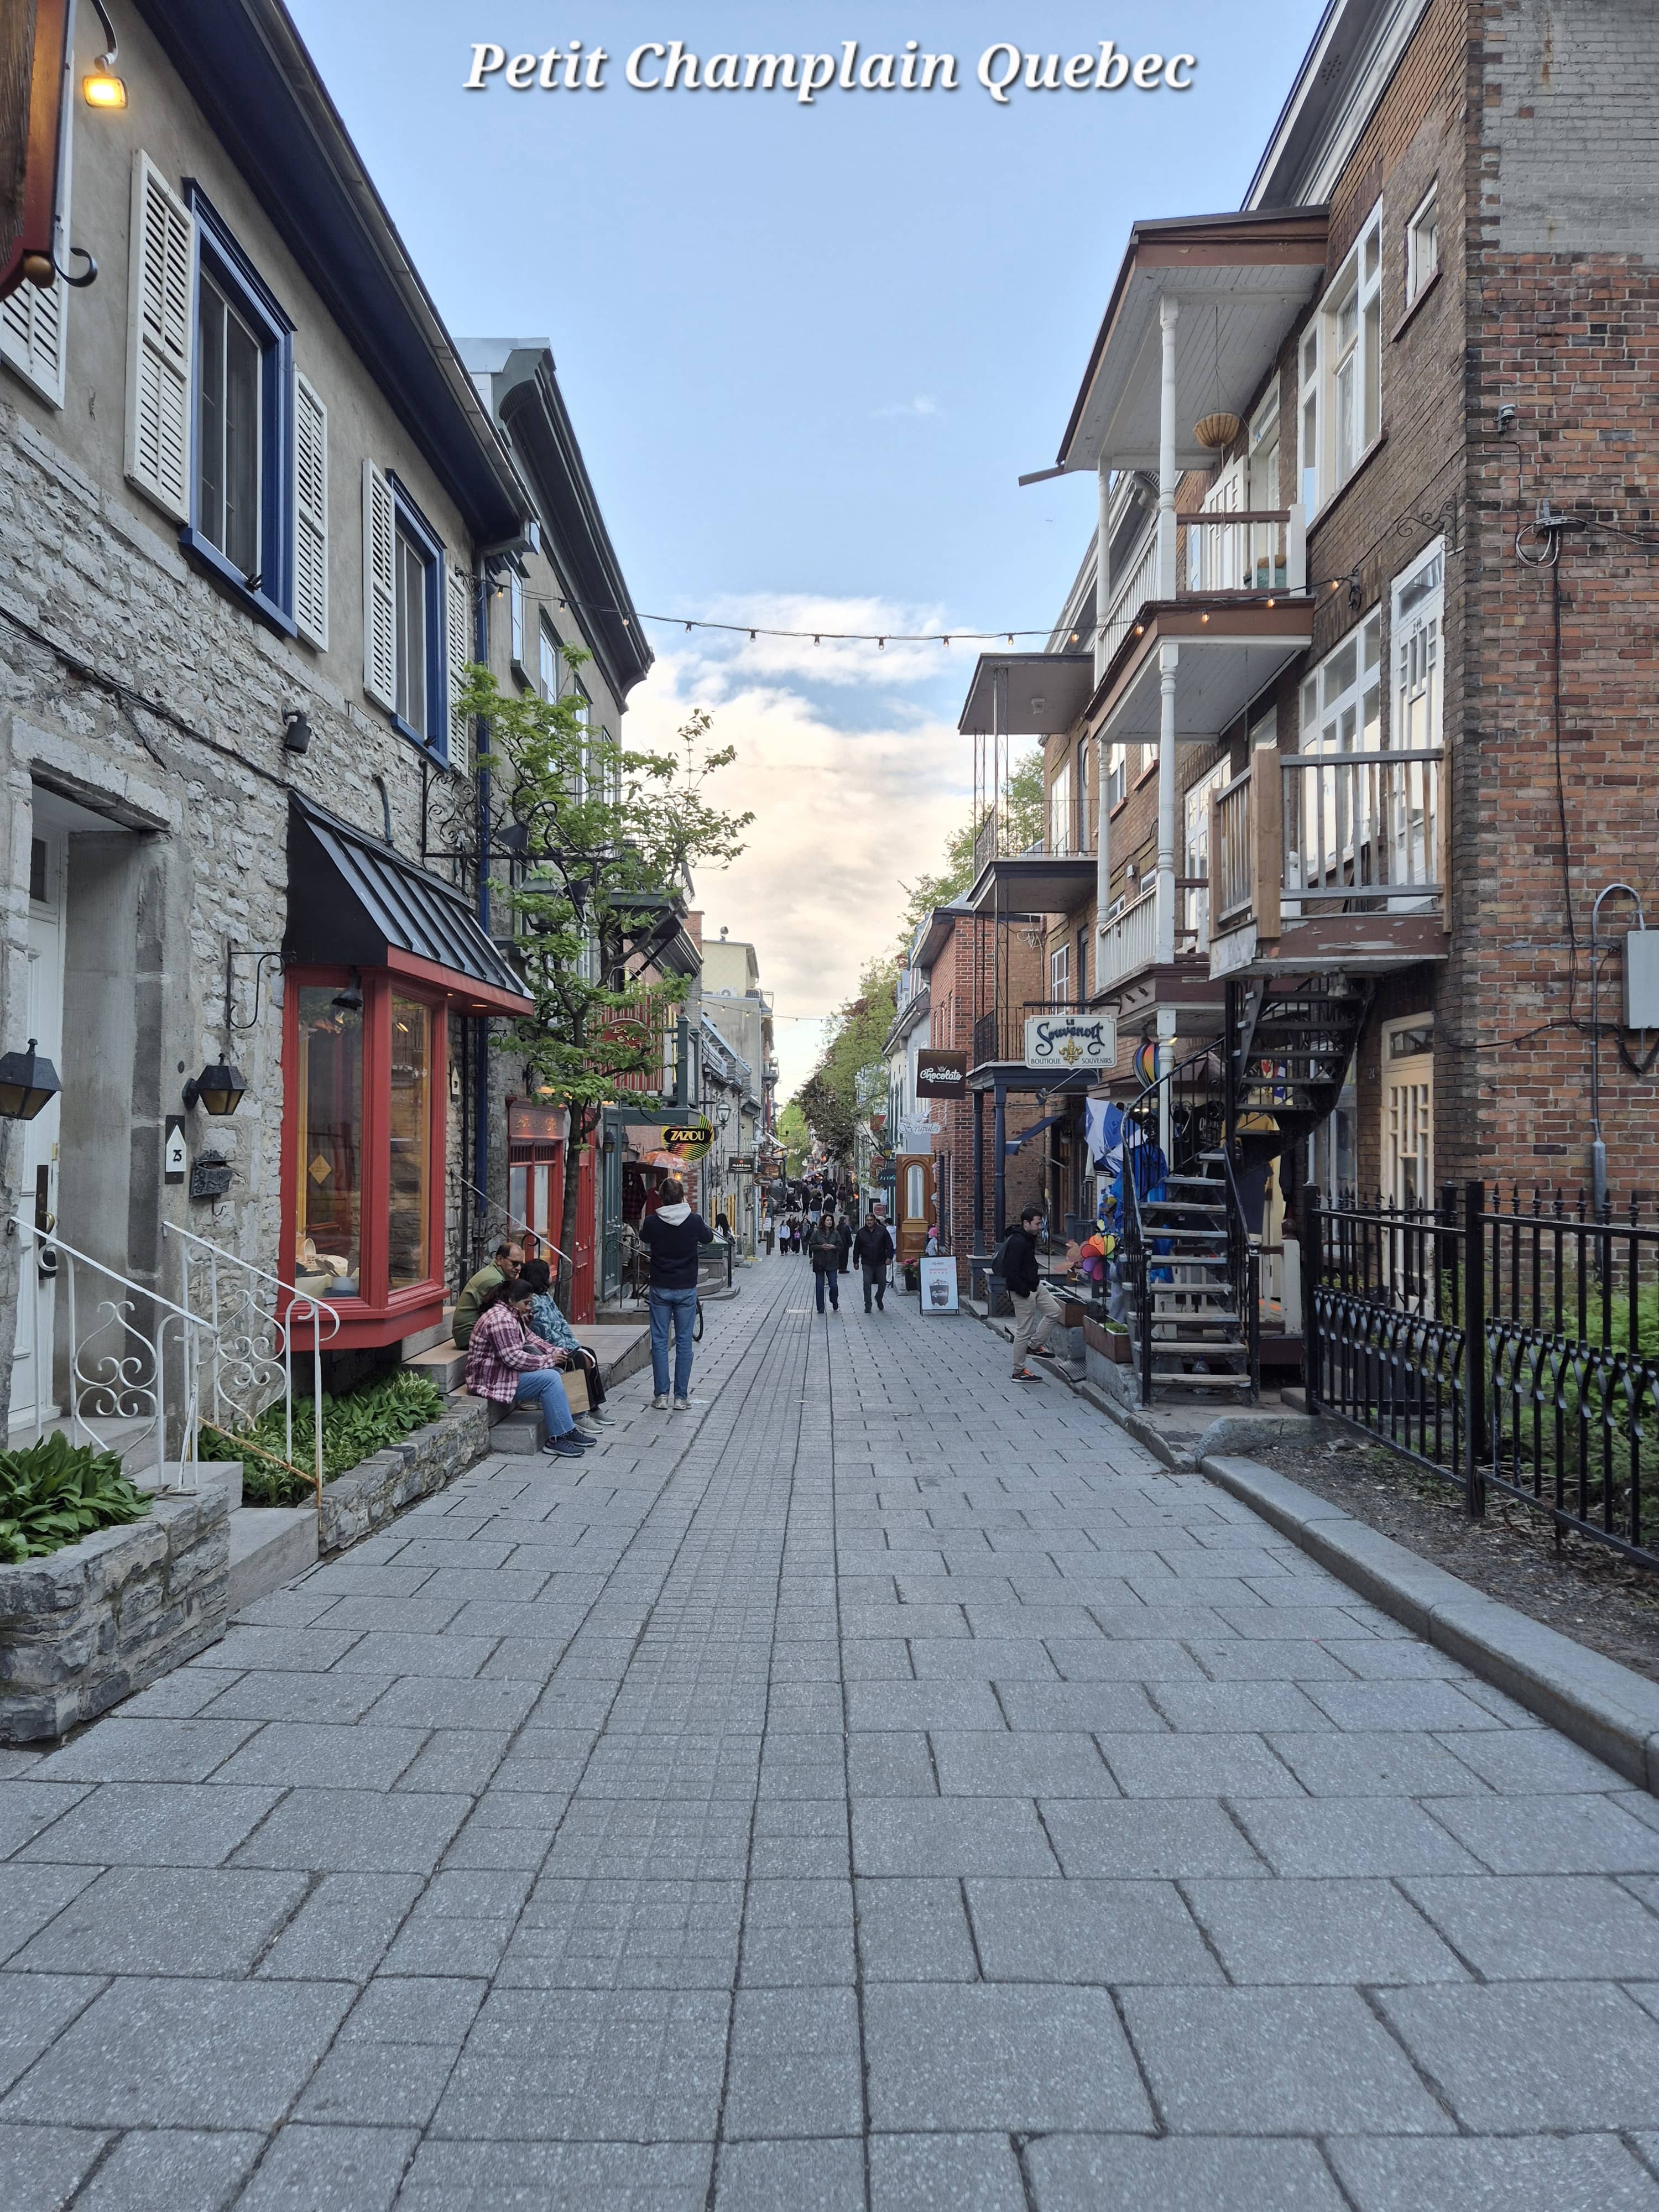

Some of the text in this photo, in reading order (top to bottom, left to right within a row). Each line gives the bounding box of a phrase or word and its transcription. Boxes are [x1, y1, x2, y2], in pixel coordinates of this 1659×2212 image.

[920, 1067, 963, 1083] Chocolato
[670, 1130, 705, 1141] ZAZOU
[173, 1149, 182, 1162] 25
